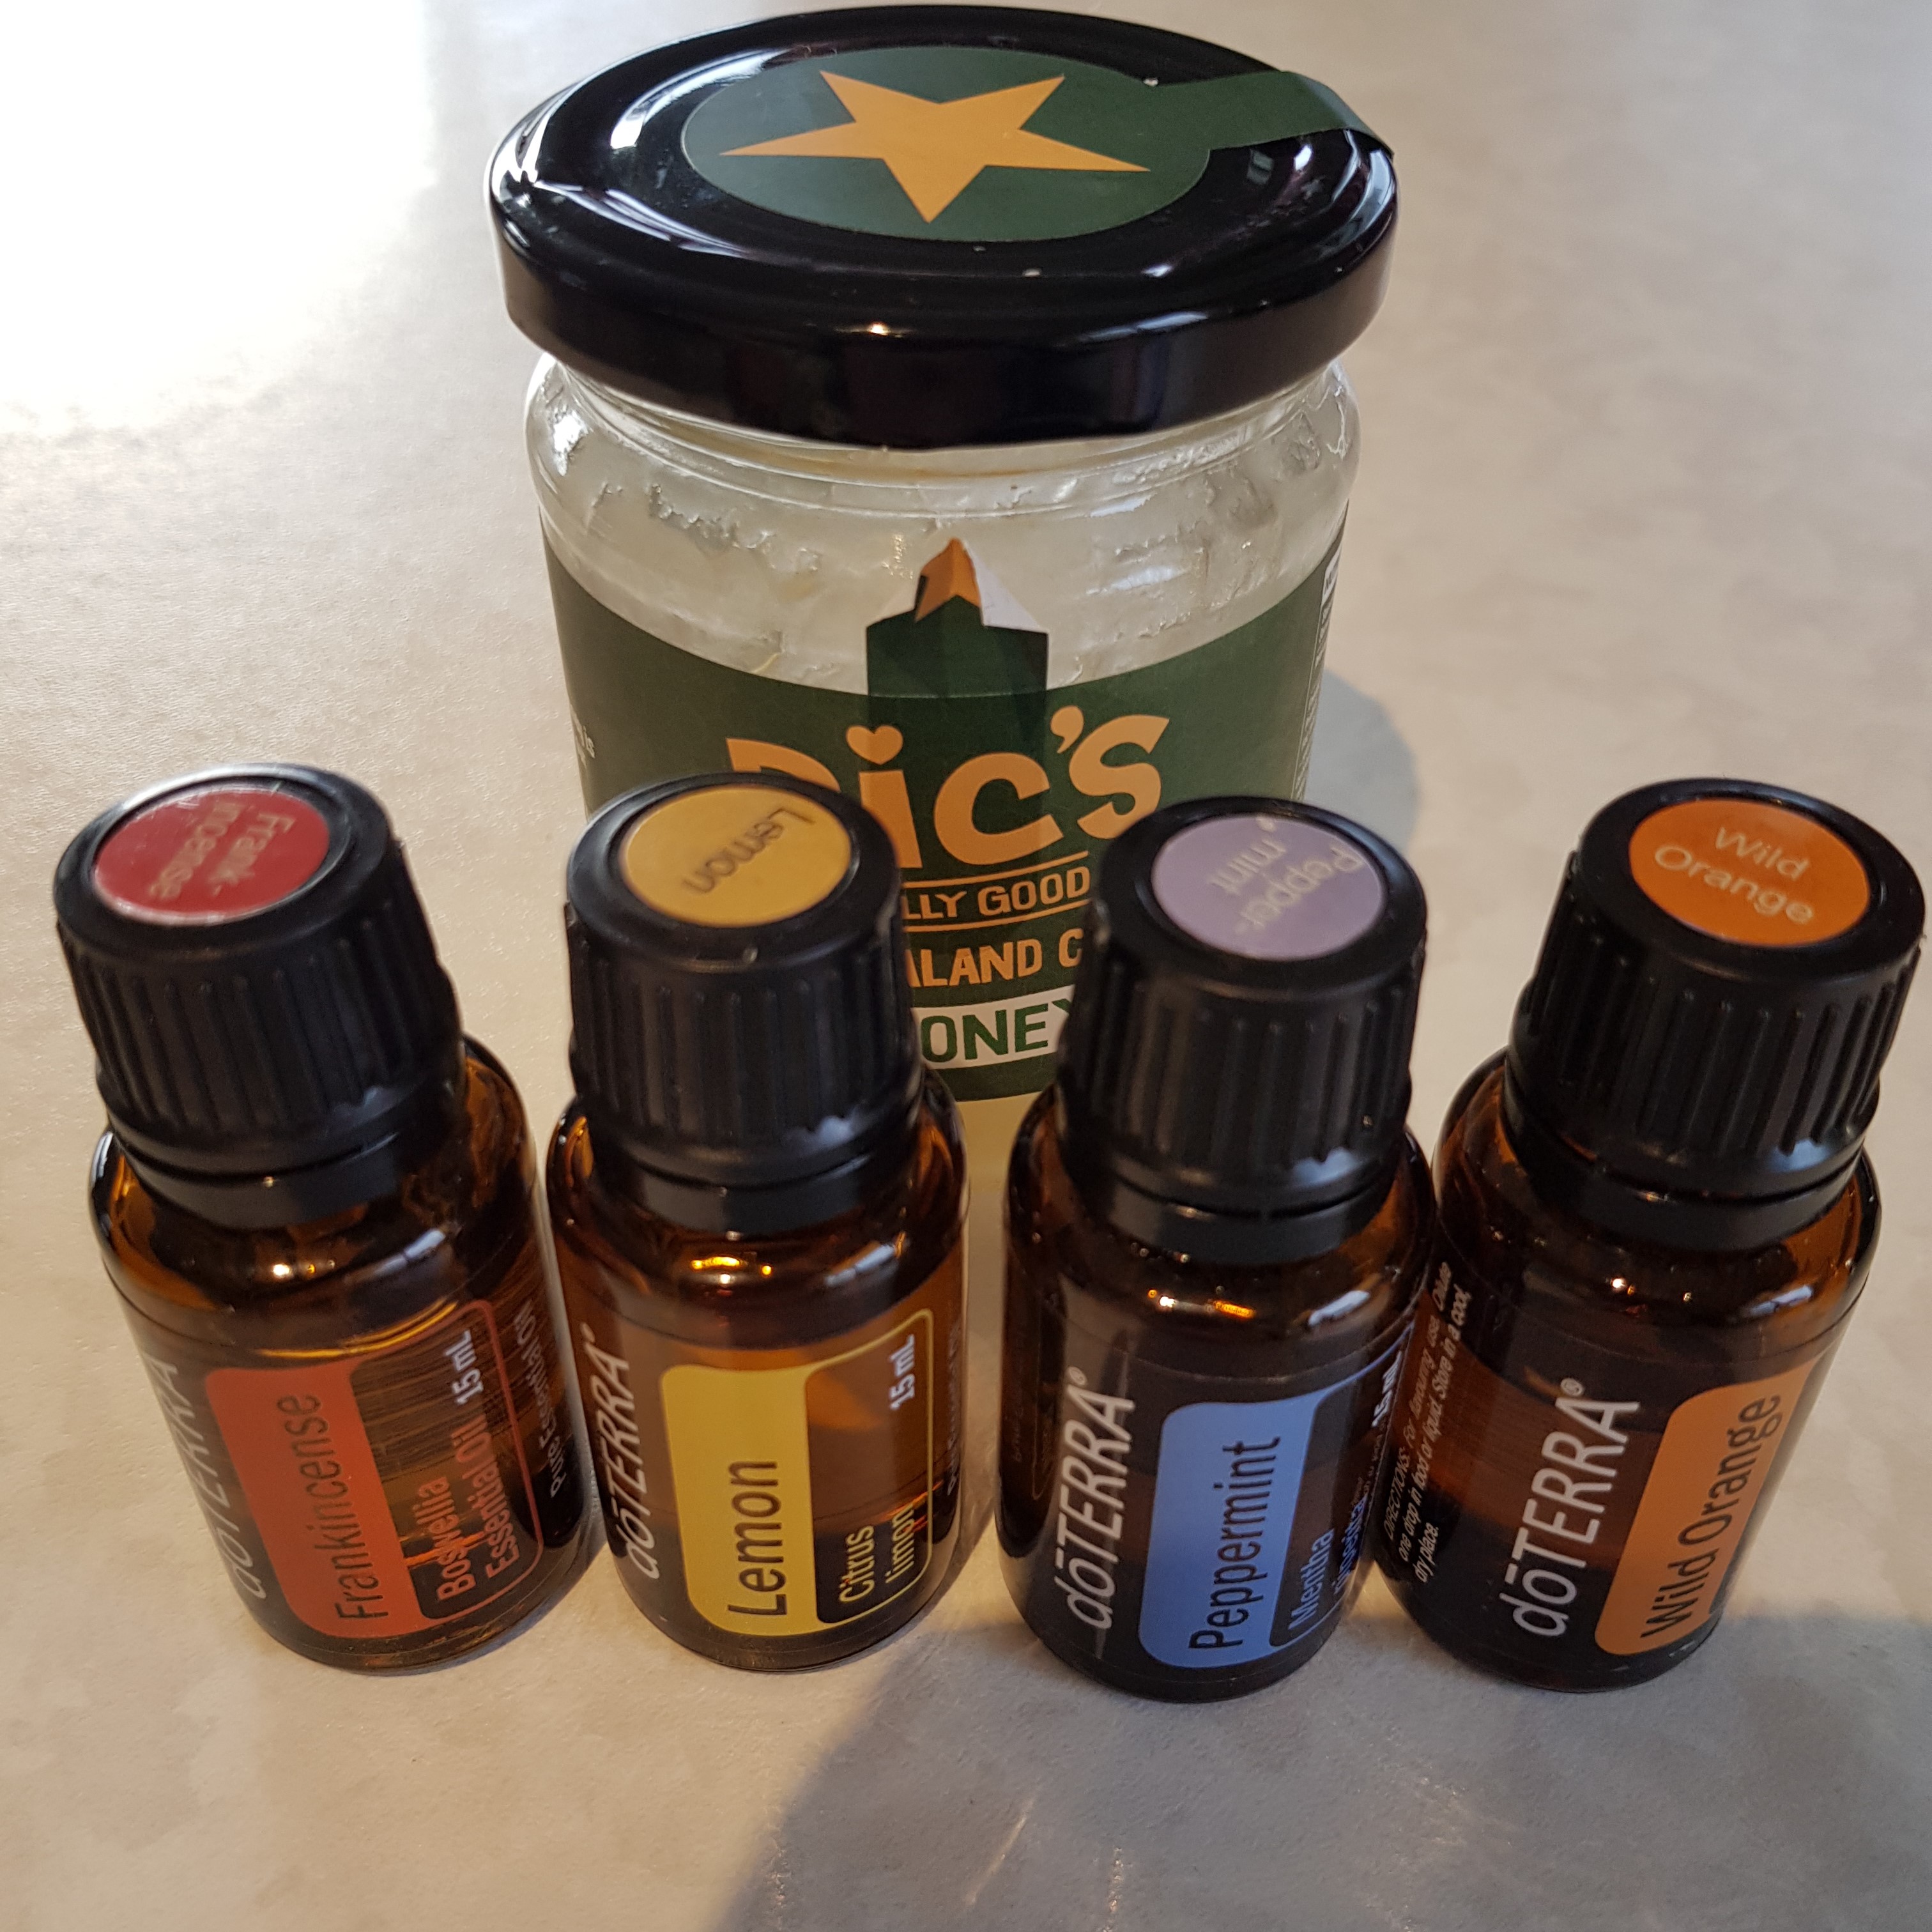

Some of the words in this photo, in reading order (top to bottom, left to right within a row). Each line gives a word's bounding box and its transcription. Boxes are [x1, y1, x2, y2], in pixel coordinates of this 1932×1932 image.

[683, 808, 816, 893] Lemon
[1715, 827, 1809, 881] Wild
[901, 891, 967, 919] LLY
[977, 866, 1090, 916] GOOD
[1655, 845, 1814, 925] Orange
[905, 938, 1042, 987] LAND
[921, 999, 1072, 1062] ONE
[444, 1330, 477, 1371] mL
[889, 1333, 914, 1377] mL
[1439, 1337, 1457, 1359] in
[1448, 1323, 1461, 1342] a
[452, 1368, 484, 1405] 15
[890, 1380, 914, 1410] 15
[1384, 1446, 1411, 1540] DIRECTIONS:
[1404, 1418, 1416, 1449] For
[1432, 1261, 1452, 1312] Dilute
[1432, 1355, 1453, 1400] Store
[1372, 1389, 1393, 1427] 15
[451, 1414, 491, 1464] Oil
[1422, 1437, 1432, 1458] or
[548, 1435, 567, 1498] Pure
[1412, 1452, 1430, 1491] food
[1678, 1393, 1781, 1547] Orange
[277, 1393, 388, 1620] Frankincense
[461, 1453, 521, 1579] Essential
[1402, 1502, 1422, 1536] drop
[1408, 1487, 1423, 1506] in
[413, 1476, 477, 1600] Boswellia
[728, 1460, 787, 1616] Lemon
[885, 1504, 914, 1584] limon
[1188, 1437, 1280, 1650] Peppermint
[1399, 1533, 1412, 1561] one
[1418, 1522, 1439, 1565] place.
[839, 1526, 875, 1602] Citrus
[1288, 1528, 1335, 1630] Mentha
[1413, 1555, 1434, 1583] dry
[1640, 1548, 1720, 1638] Wild
